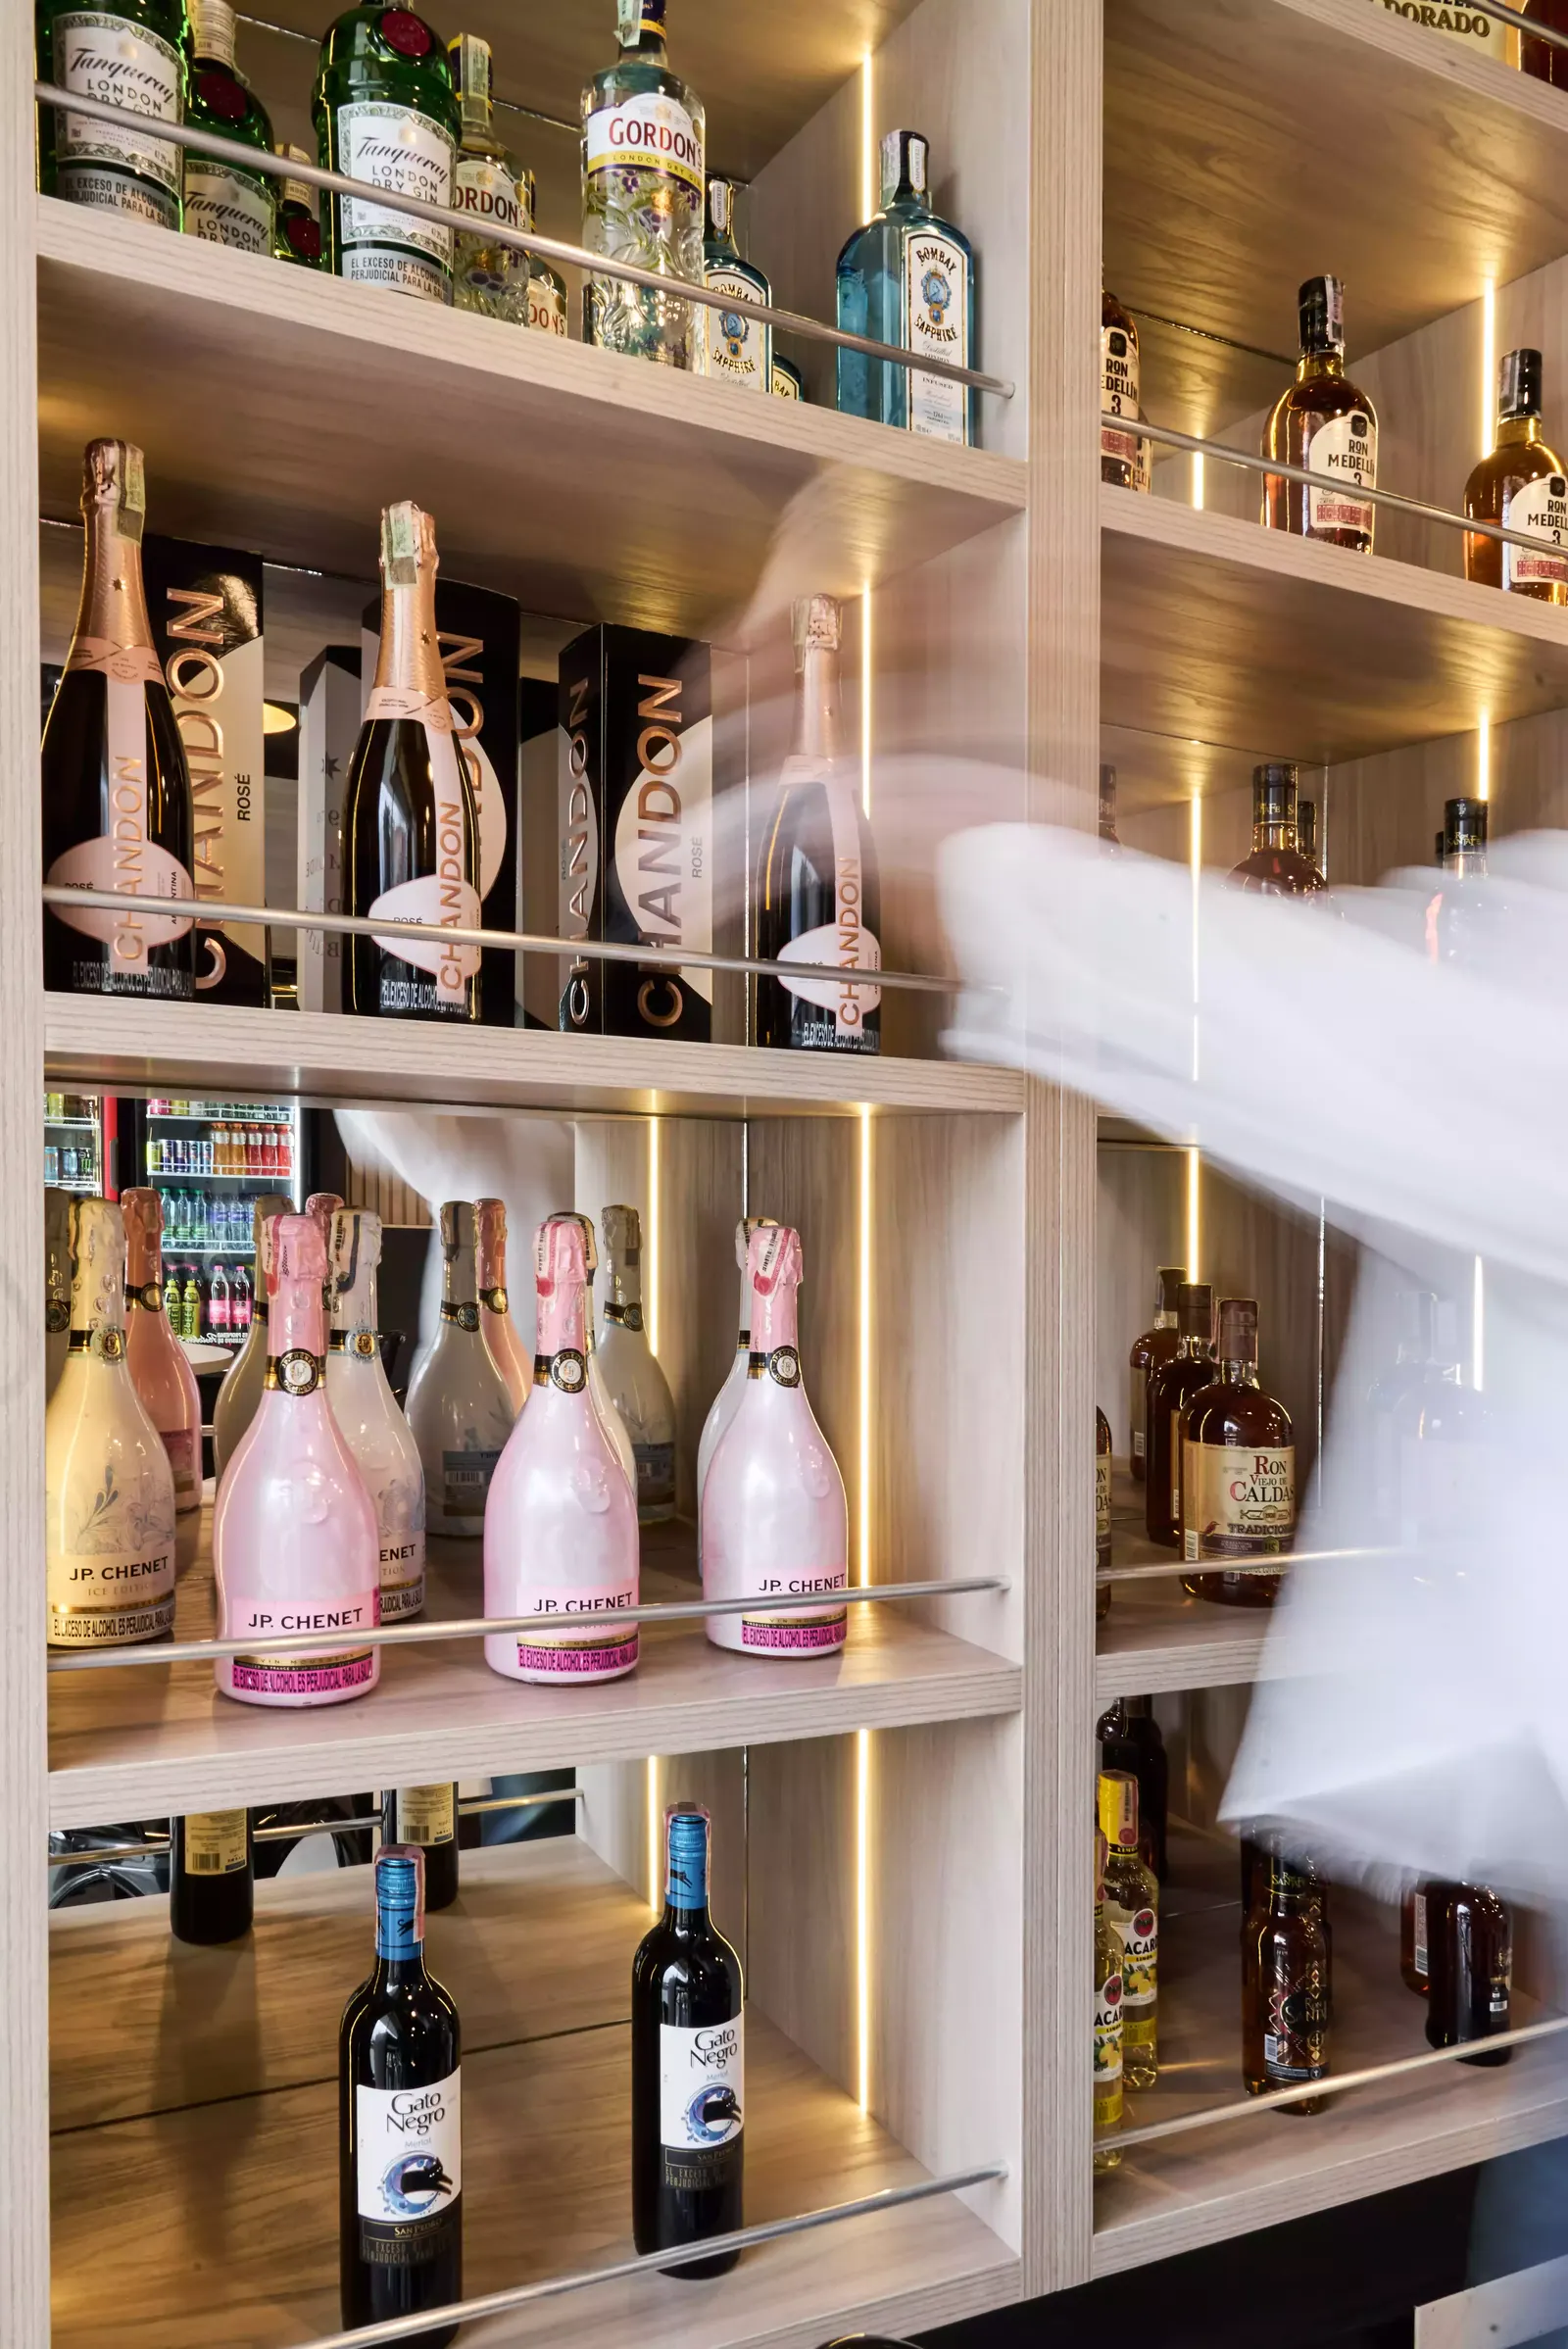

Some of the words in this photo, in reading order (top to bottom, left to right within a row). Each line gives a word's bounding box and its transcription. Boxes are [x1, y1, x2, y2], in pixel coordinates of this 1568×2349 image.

[70, 47, 175, 105] Tanqueray
[86, 77, 163, 114] LONDON
[609, 118, 704, 168] GORDON'S
[356, 136, 450, 185] Tanqueray
[612, 155, 661, 166] LONDON
[666, 162, 685, 173] DRY
[371, 164, 439, 194] LONDON
[76, 176, 113, 192] EXCESO
[116, 181, 127, 196] DE
[130, 186, 166, 214] ALCOHOL
[371, 178, 413, 196] DRY
[412, 186, 439, 205] GIN
[65, 189, 119, 207] PERJUDICIAL
[121, 196, 144, 214] PARA
[145, 208, 156, 221] LA
[157, 213, 172, 229] SAL
[184, 191, 270, 240] Tanqueray
[453, 185, 527, 228] ORDON'S
[197, 218, 261, 249] LONDON
[351, 257, 360, 269] EL
[363, 256, 395, 269] EXCESO
[397, 260, 409, 272] DE
[411, 264, 442, 286] ALCOHOL
[915, 246, 957, 275] BOMBAY
[351, 269, 401, 283] PERJUDICIAL
[402, 274, 422, 289] PARA
[423, 280, 432, 294] LA
[433, 285, 445, 301] SAL
[712, 283, 754, 303] OMBA
[529, 303, 565, 335] DON'S
[913, 313, 958, 343] SAPPHIRE
[711, 347, 758, 374] SAPPHIRE
[1105, 358, 1129, 378] RON
[774, 379, 790, 397] BAY
[922, 377, 954, 390] INFUSED
[1110, 394, 1122, 416] 3
[1348, 438, 1369, 457] RON
[1353, 471, 1362, 486] 3
[1546, 499, 1567, 515] RON
[1527, 514, 1568, 530] MEDELL
[1551, 529, 1561, 545] 3
[237, 773, 251, 822] ROSÉ
[112, 756, 144, 961] CHANDON
[637, 673, 683, 1027] CHANDON
[691, 835, 704, 879] ROSÉ
[439, 802, 464, 992] CHANDON
[838, 856, 860, 1027] CHANDON
[1096, 1467, 1107, 1483] ON
[1253, 1455, 1287, 1475] RON
[1229, 1481, 1295, 1503] CALDAS
[1250, 1474, 1278, 1487] VIEJO
[1279, 1477, 1288, 1486] DE
[1096, 1492, 1112, 1512] DAS
[1227, 1522, 1286, 1536] TRADICIO
[379, 1542, 416, 1562] ENET
[69, 1568, 95, 1581] JP.
[101, 1555, 169, 1581] CHENET
[381, 1566, 406, 1576] TION
[87, 1588, 108, 1596] ICE
[759, 1579, 782, 1591] JP.
[788, 1573, 845, 1592] CHENET
[533, 1598, 559, 1613] JP.
[564, 1590, 633, 1612] CHENET
[83, 1619, 91, 1638] DE
[92, 1618, 118, 1638] ALCOHOL
[118, 1617, 125, 1636] ES
[248, 1613, 273, 1628] JP.
[280, 1607, 363, 1630] CHENET
[742, 1627, 750, 1644] EL
[750, 1628, 770, 1647] EXCESO
[770, 1630, 778, 1647] DE
[778, 1630, 802, 1648] ALCOHOL
[519, 1648, 526, 1667] EL
[526, 1649, 547, 1670] EXCESO
[548, 1651, 556, 1672] DE
[557, 1651, 582, 1672] ALCOHOL
[583, 1651, 590, 1672] ES
[297, 1673, 305, 1693] ES
[306, 1669, 341, 1692] PERJUDICIAL
[1124, 1933, 1157, 1956] ACAR
[1094, 2007, 1123, 2027] ACAR
[694, 2029, 736, 2052] Gato
[689, 2042, 738, 2070] Negro
[706, 2069, 729, 2081] Merlot
[391, 2092, 442, 2116] Gato
[386, 2107, 446, 2135] Negro
[404, 2136, 432, 2150] Merlot
[394, 2227, 413, 2238] SAN
[375, 2241, 407, 2254] EXCESO
